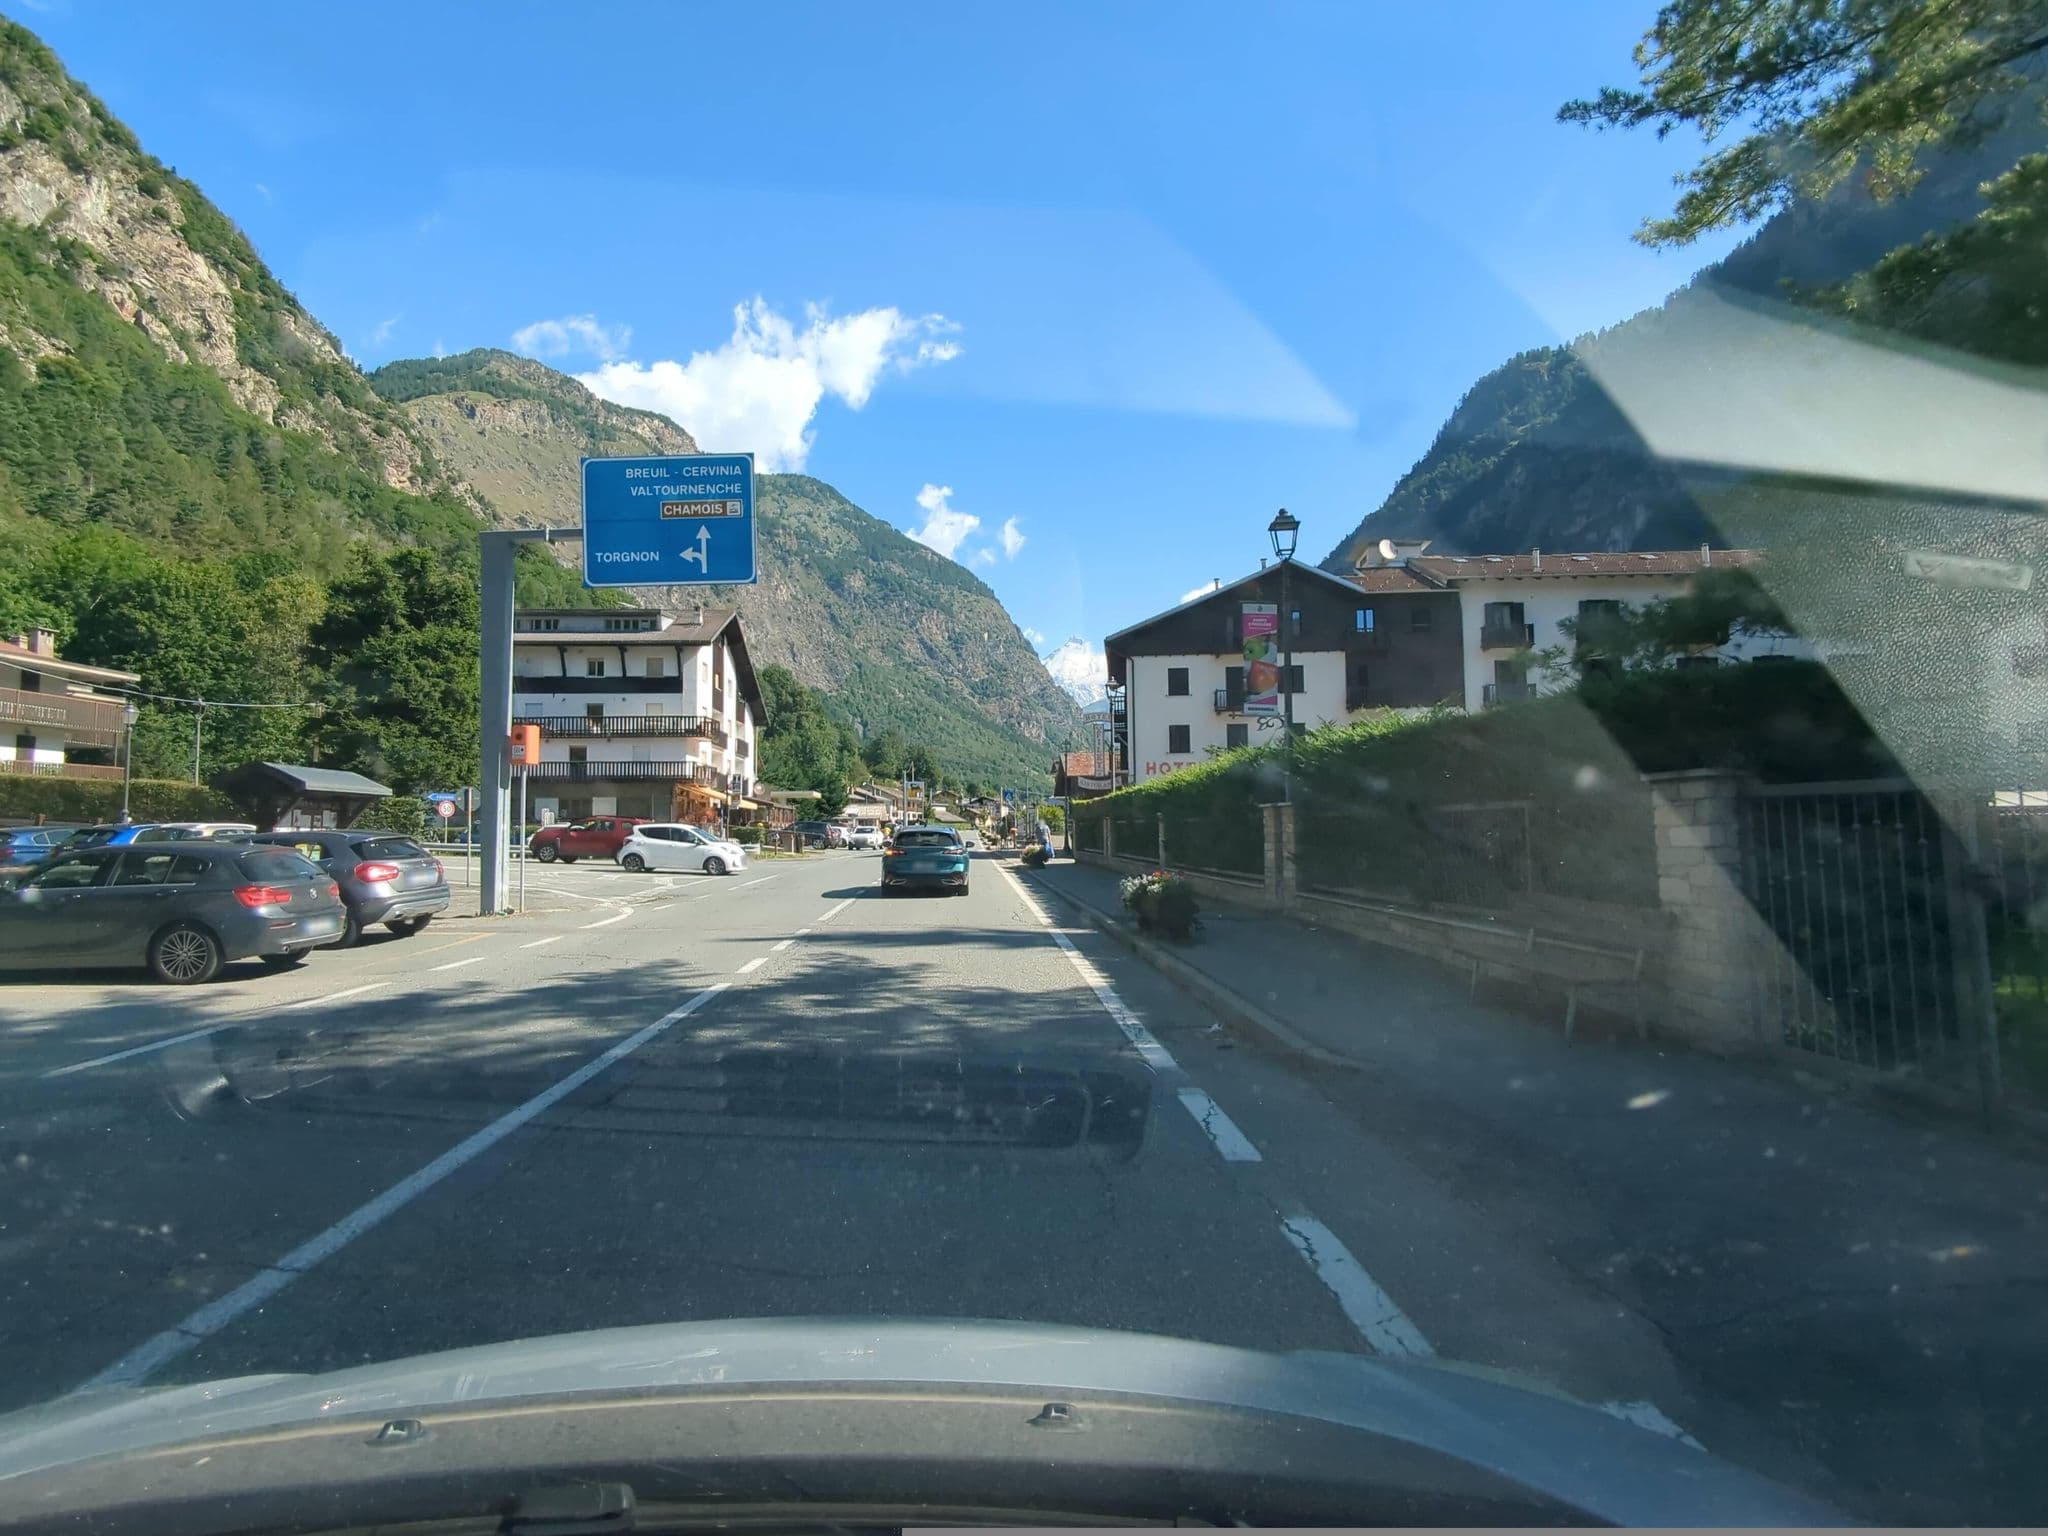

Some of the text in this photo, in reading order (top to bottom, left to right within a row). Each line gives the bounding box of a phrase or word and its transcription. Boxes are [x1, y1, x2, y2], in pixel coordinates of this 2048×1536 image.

[625, 467, 670, 479] BREUIL
[682, 465, 742, 477] CERVINIA
[630, 483, 742, 496] VALTOURNENCHE
[663, 504, 723, 516] CHAMOIS
[595, 551, 660, 563] TORGNON
[1146, 761, 1196, 775] HOT
